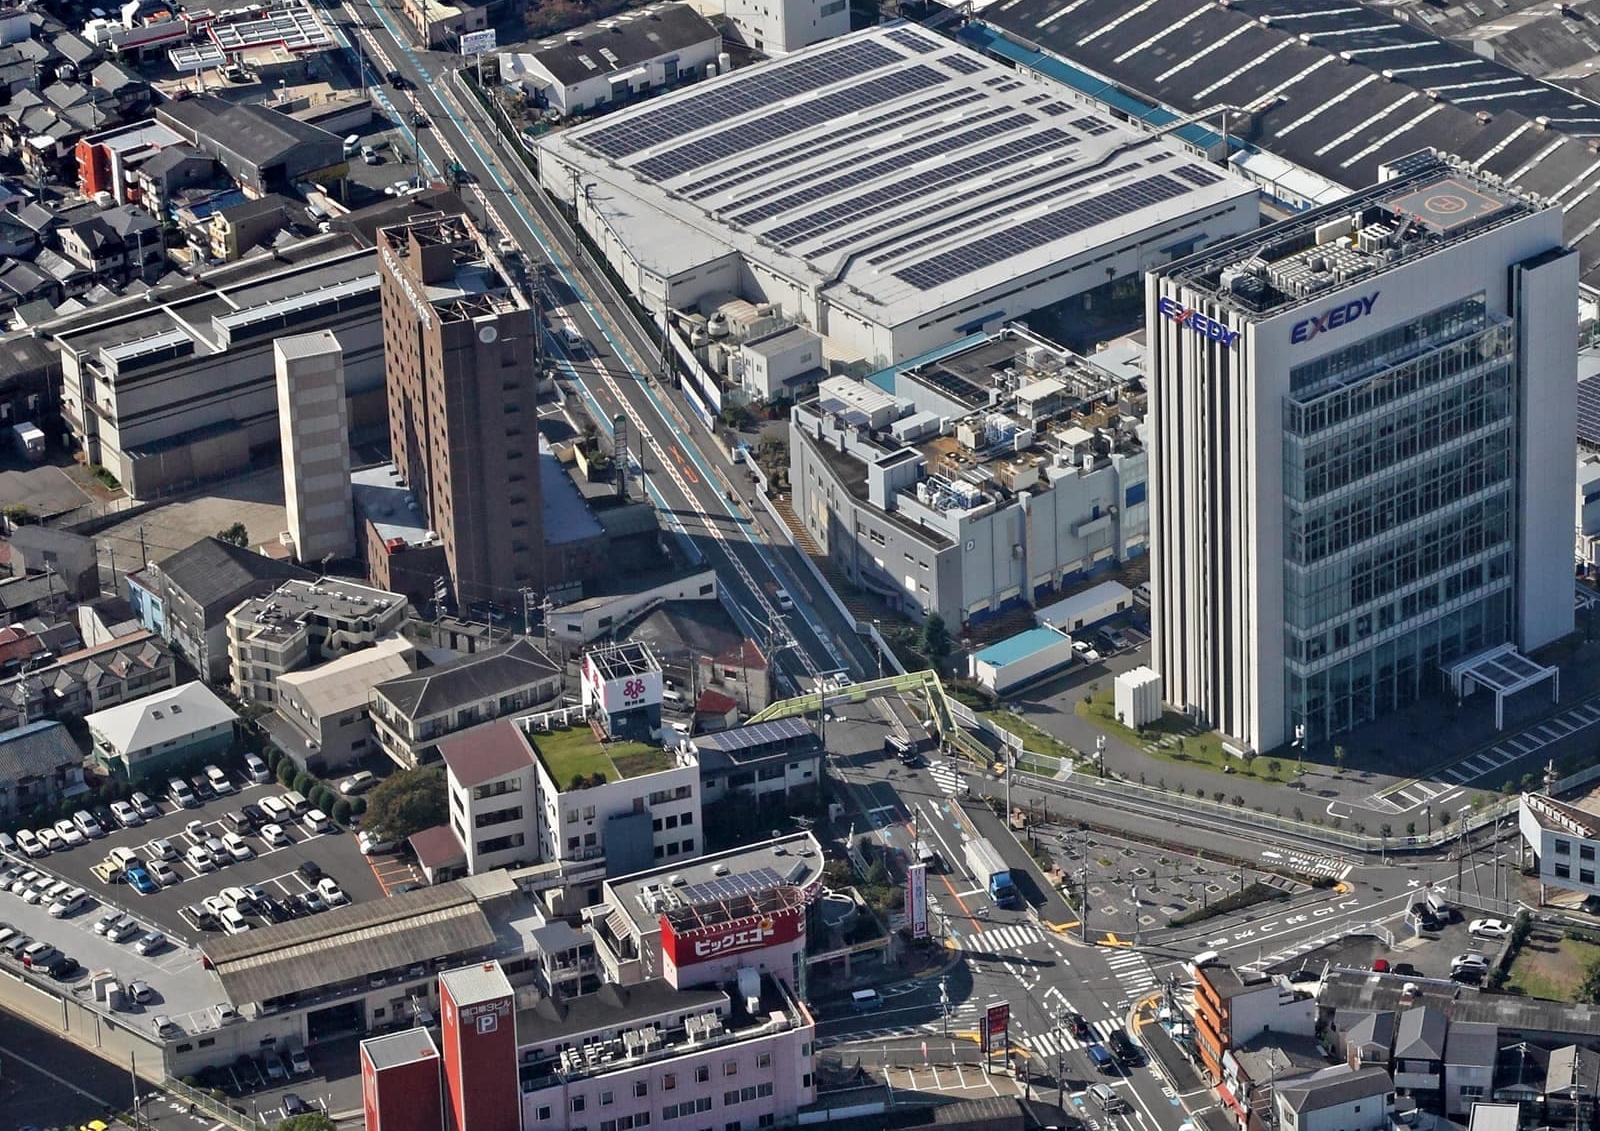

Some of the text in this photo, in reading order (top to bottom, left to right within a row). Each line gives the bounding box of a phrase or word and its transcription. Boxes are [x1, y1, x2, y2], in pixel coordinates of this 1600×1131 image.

[1160, 296, 1240, 347] EXEDY
[1291, 292, 1380, 345] EXEDY
[481, 1017, 493, 1032] P
